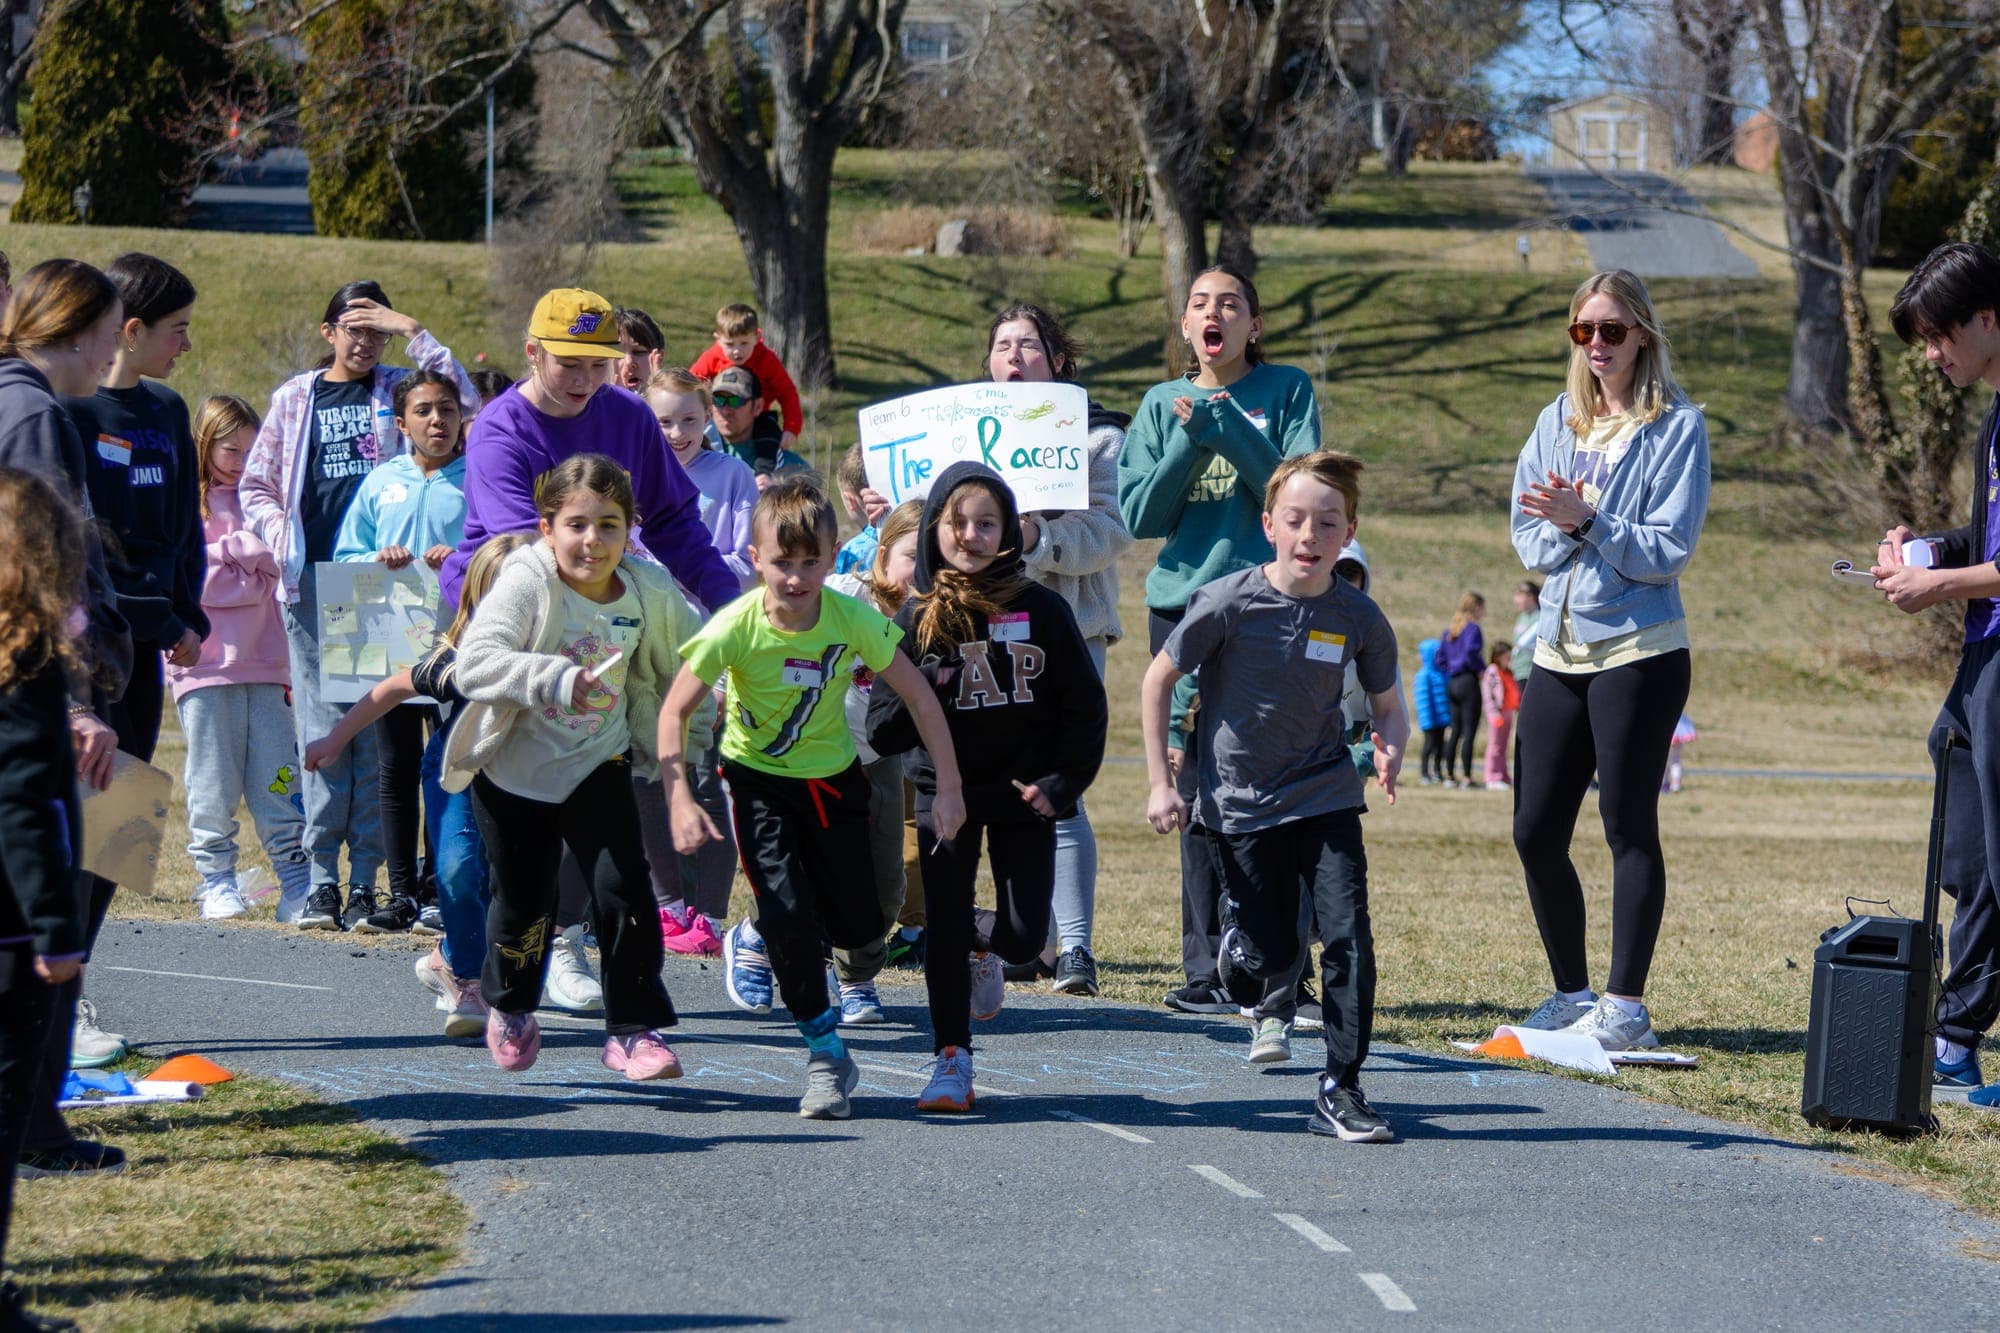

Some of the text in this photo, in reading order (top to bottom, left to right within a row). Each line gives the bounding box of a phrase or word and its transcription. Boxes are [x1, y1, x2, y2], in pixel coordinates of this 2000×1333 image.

[317, 405, 372, 425] VIRGINI
[901, 398, 911, 418] 6
[320, 420, 374, 443] BEAC
[869, 416, 1081, 504] The Racers
[132, 467, 163, 485] JMU
[794, 671, 801, 682] 6
[955, 640, 1045, 709] AP
